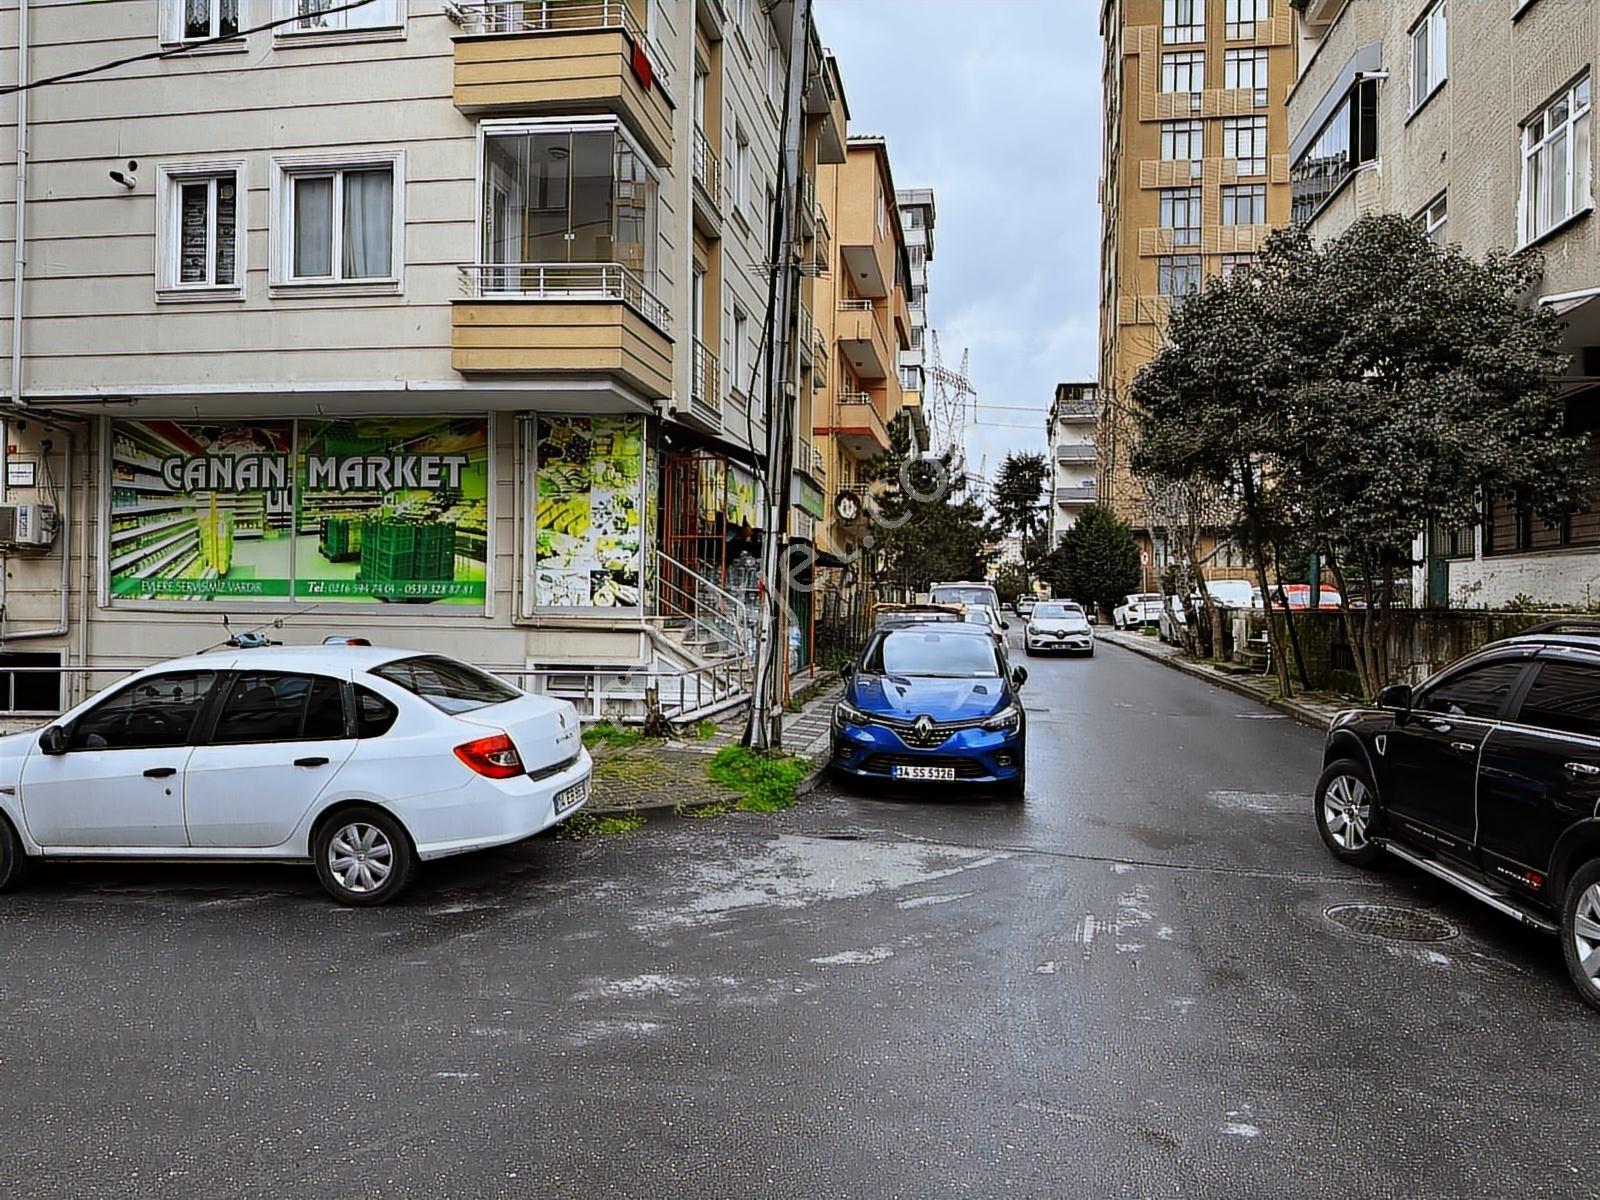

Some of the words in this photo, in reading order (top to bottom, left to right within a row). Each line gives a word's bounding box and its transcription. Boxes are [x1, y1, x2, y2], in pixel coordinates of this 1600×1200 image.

[162, 455, 286, 492] CANAN
[308, 455, 468, 492] MARKET
[141, 580, 174, 592] EVLERE
[227, 581, 263, 593] VARDIR
[404, 583, 428, 594] 0539
[897, 767, 910, 777] 34
[912, 767, 926, 778] SS
